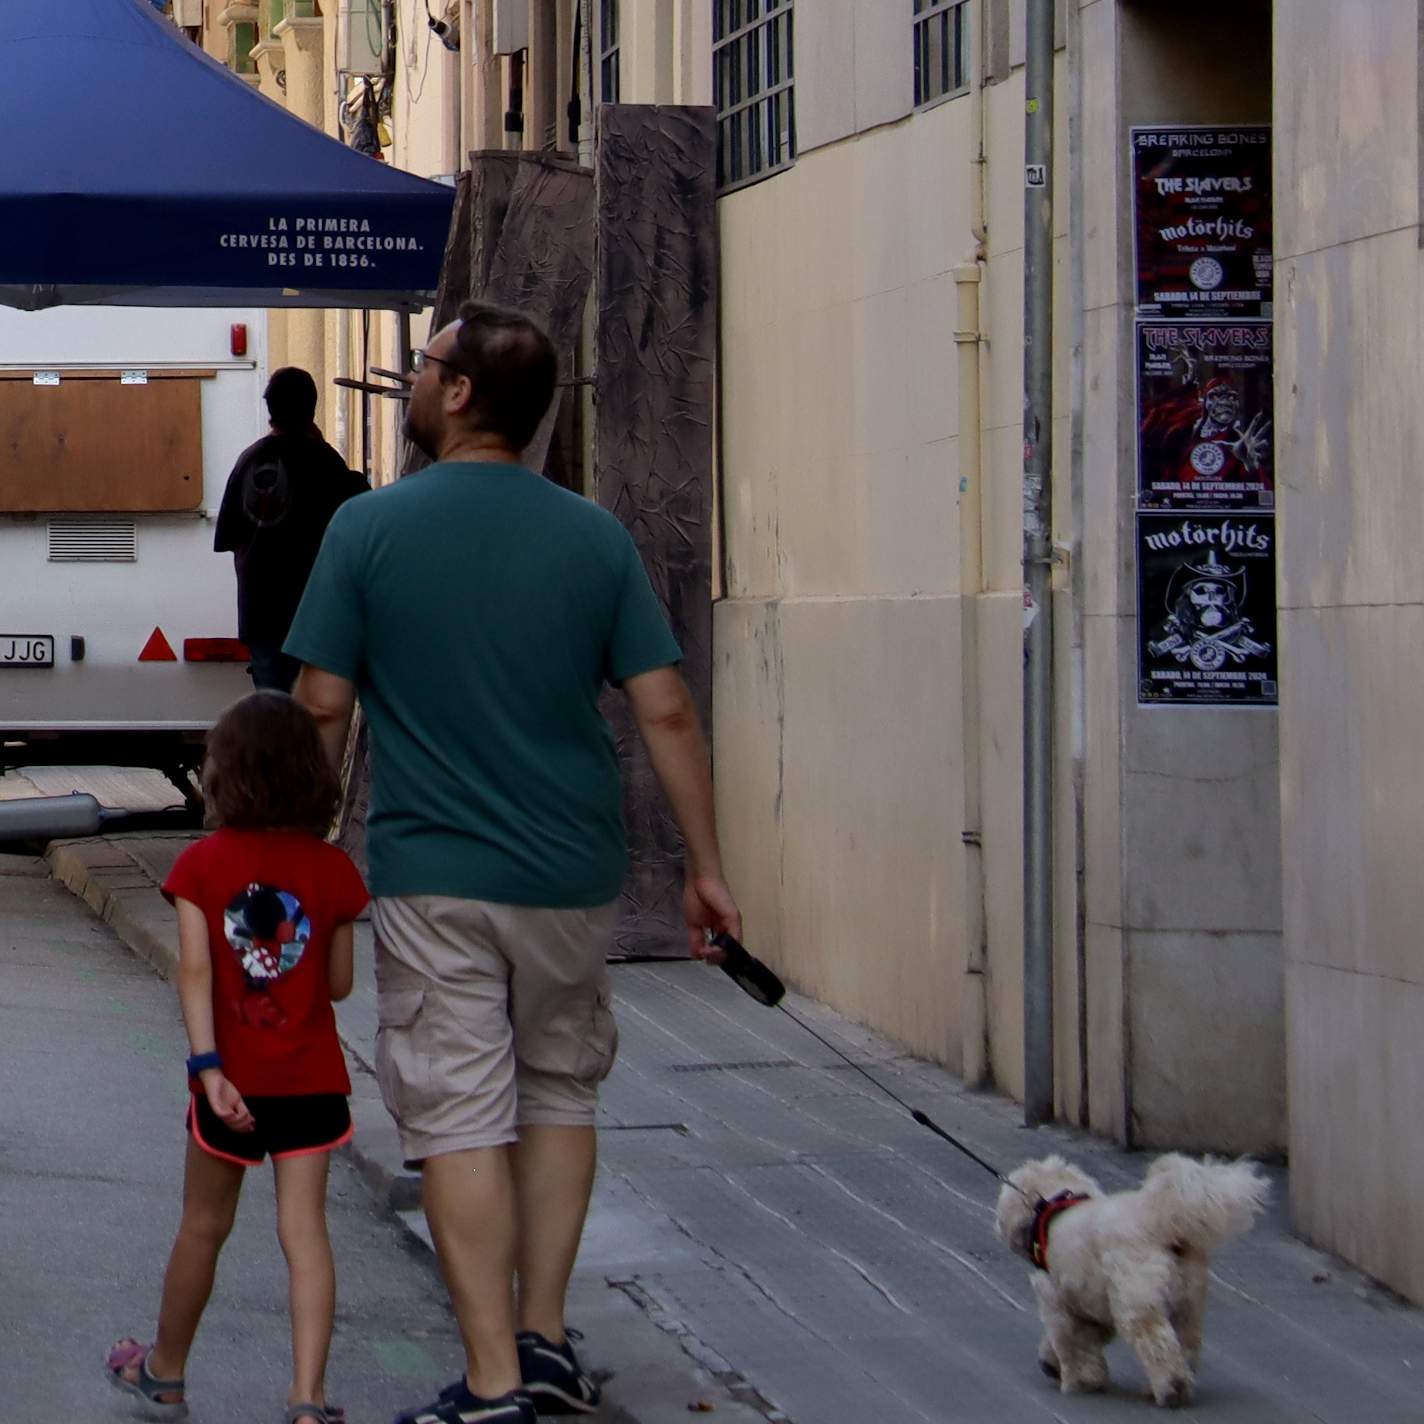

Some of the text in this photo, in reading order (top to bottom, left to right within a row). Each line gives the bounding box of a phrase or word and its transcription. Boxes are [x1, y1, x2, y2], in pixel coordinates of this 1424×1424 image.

[1137, 133, 1267, 147] BREAKING BONES
[1155, 177, 1252, 196] THE SLAVERS
[269, 217, 370, 232] LA PRIMERA
[1159, 216, 1254, 241] motörhits
[220, 234, 424, 250] CERVESA DE BARCELONA.
[268, 252, 376, 268] DES DE 1856.
[1211, 291, 1261, 301] SEPTIEMBRE
[1142, 327, 1268, 351] THE SLAVERS
[1202, 481, 1245, 490] SEPTIEMBRE
[1144, 520, 1270, 552] motörhits
[4, 640, 46, 661] JJG
[1202, 671, 1247, 680] SEPTIEMBRE
